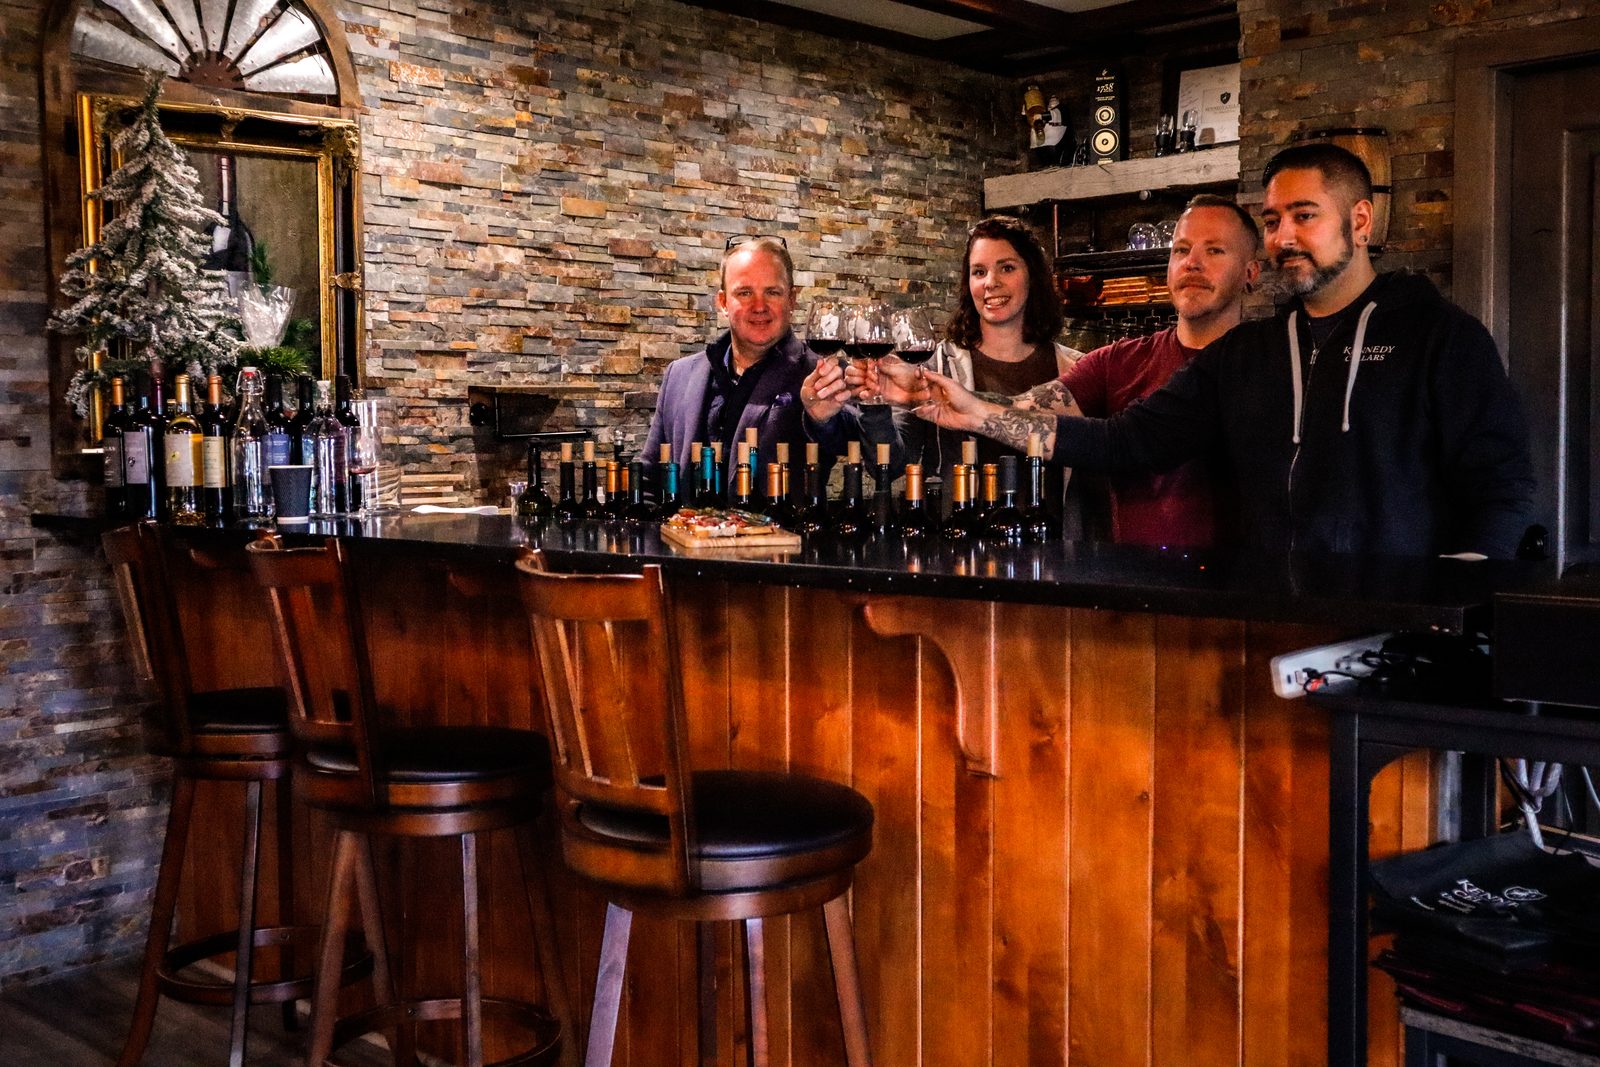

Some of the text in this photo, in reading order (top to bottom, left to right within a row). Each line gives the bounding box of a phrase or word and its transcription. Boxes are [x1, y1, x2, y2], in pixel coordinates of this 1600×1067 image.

[1096, 82, 1115, 94] 1738
[1343, 345, 1395, 354] KNNEDY
[1344, 354, 1385, 362] CLARS
